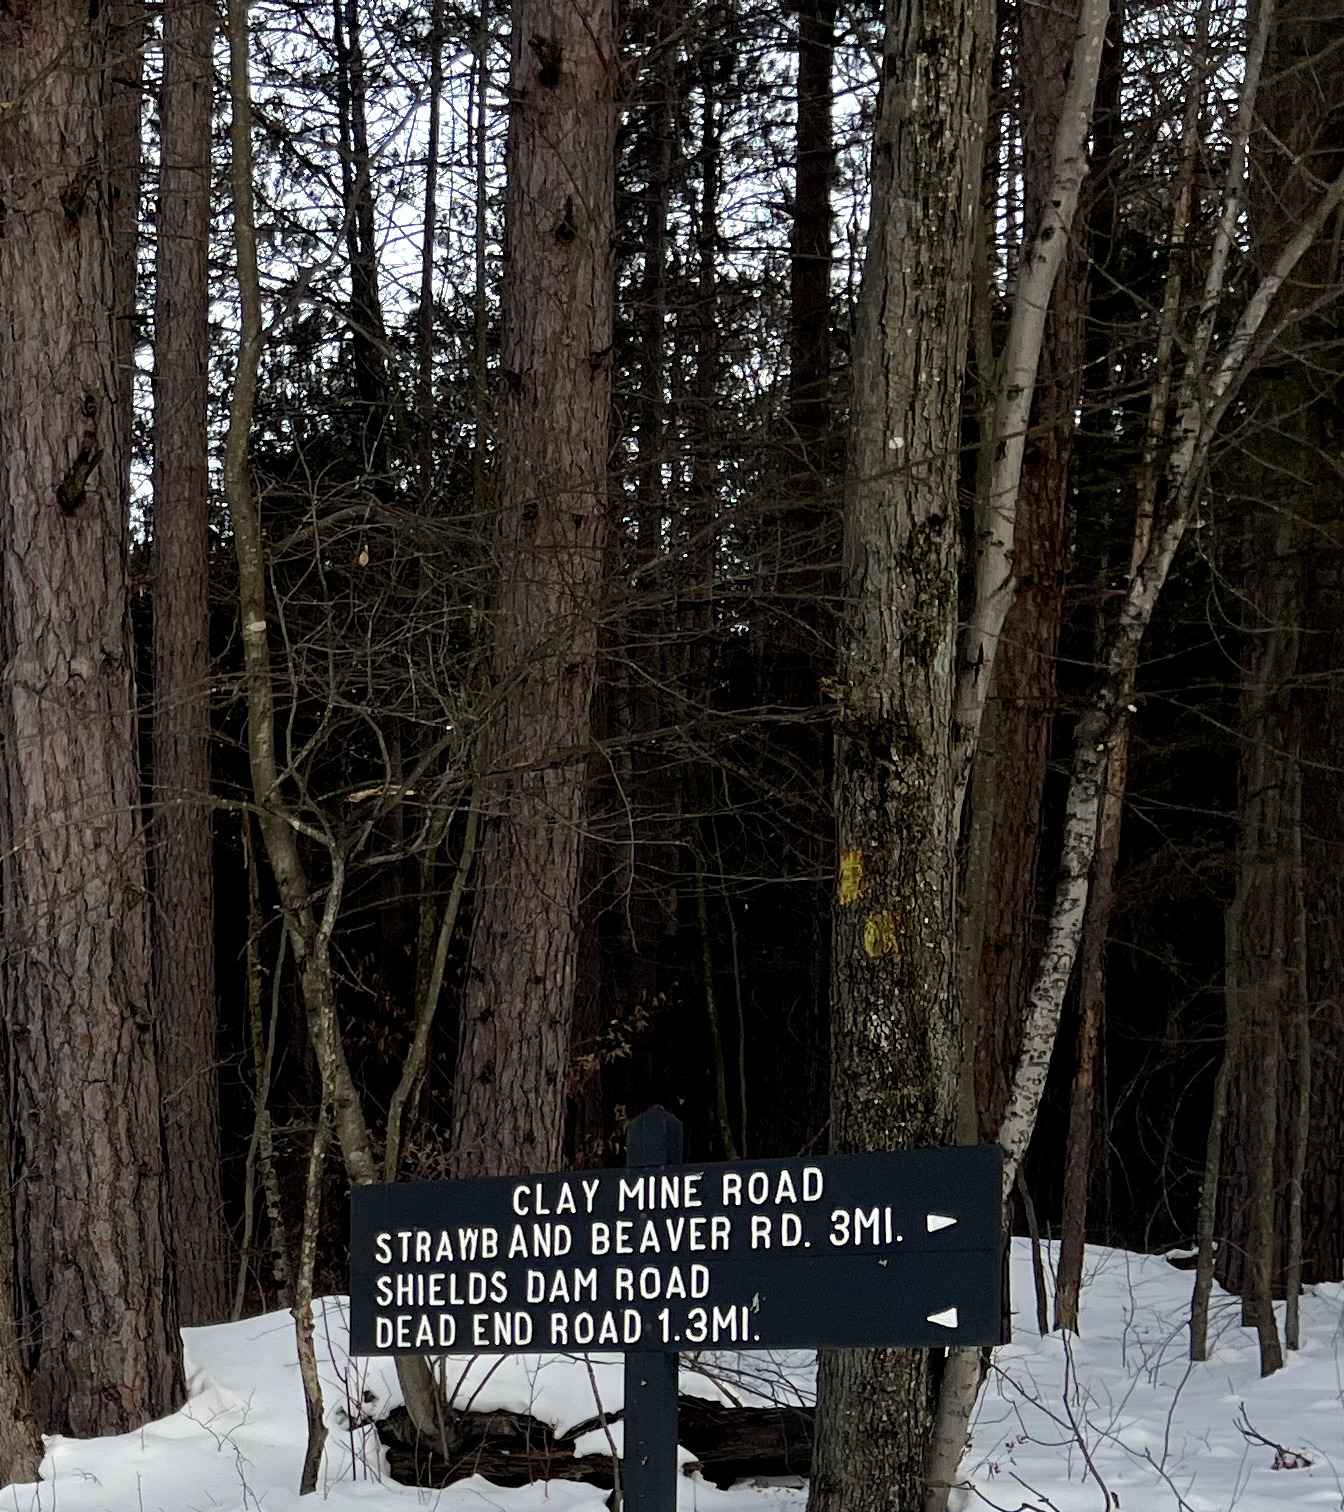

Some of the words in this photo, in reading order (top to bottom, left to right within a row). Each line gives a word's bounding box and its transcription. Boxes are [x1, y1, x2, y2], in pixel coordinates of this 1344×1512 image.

[512, 1178, 600, 1216] CLAY
[618, 1173, 703, 1212] MINE
[722, 1166, 824, 1206] ROAD
[591, 1215, 731, 1255] BEAVER
[751, 1212, 812, 1249] RD.
[376, 1270, 508, 1307] SHIELDS
[526, 1267, 598, 1304] DAM
[615, 1263, 710, 1302] ROAD
[376, 1313, 456, 1349] DEAD
[473, 1311, 533, 1346] END
[550, 1308, 642, 1345] ROAD
